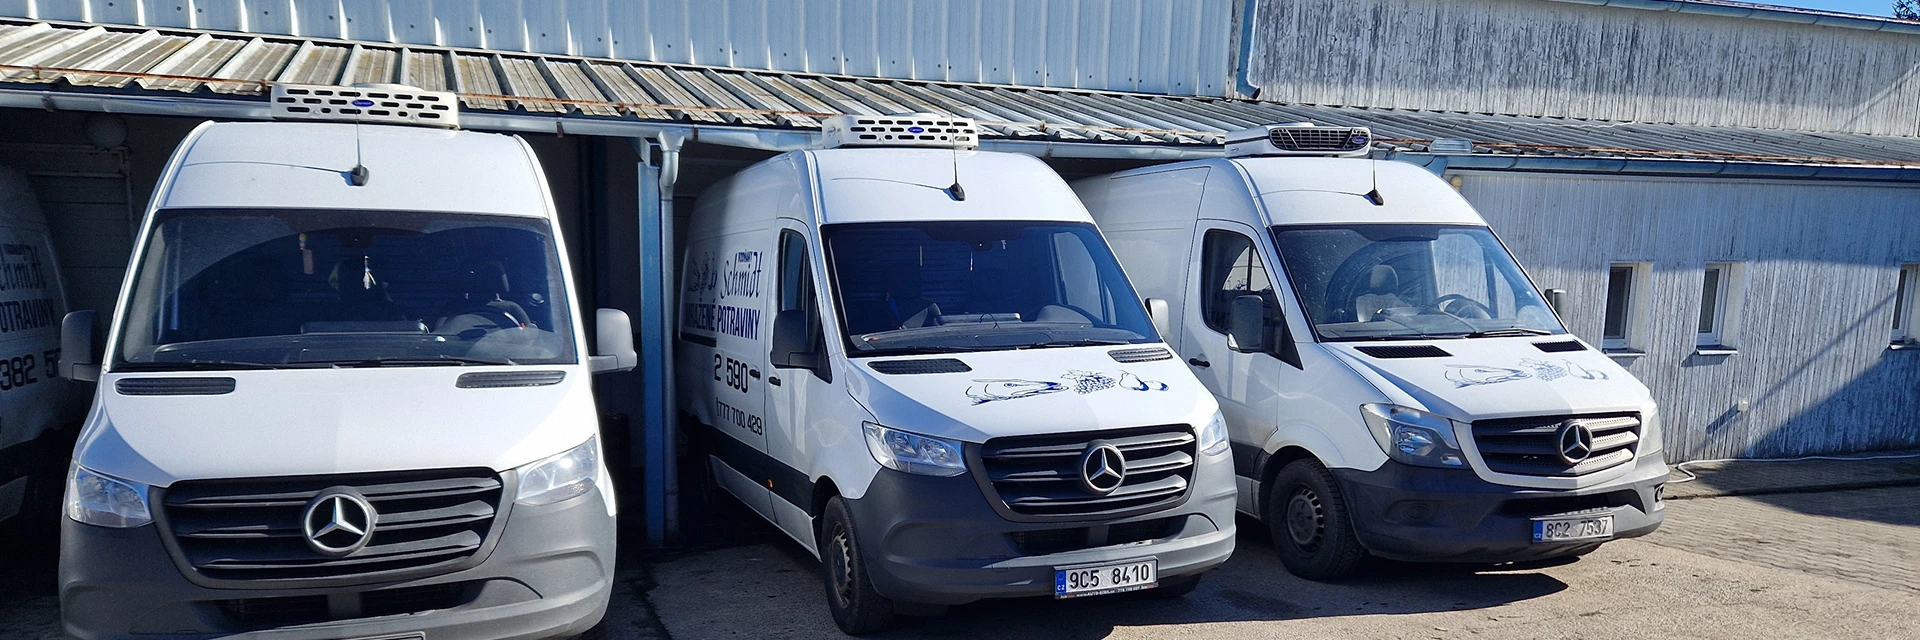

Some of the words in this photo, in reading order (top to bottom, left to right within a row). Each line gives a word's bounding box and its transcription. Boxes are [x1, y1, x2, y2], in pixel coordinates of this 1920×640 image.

[720, 251, 763, 299] Schmidt
[0, 299, 55, 333] OTRAVINY
[716, 305, 761, 340] POTRAVINY
[0, 354, 38, 391] 382
[714, 354, 722, 381] 2
[726, 357, 748, 393] 590
[731, 407, 746, 429] 700
[747, 414, 763, 436] 429
[1546, 522, 1570, 538] 8C2
[1580, 519, 1608, 537] 7537
[1069, 570, 1100, 589] 9C5
[1112, 564, 1149, 585] 8410
